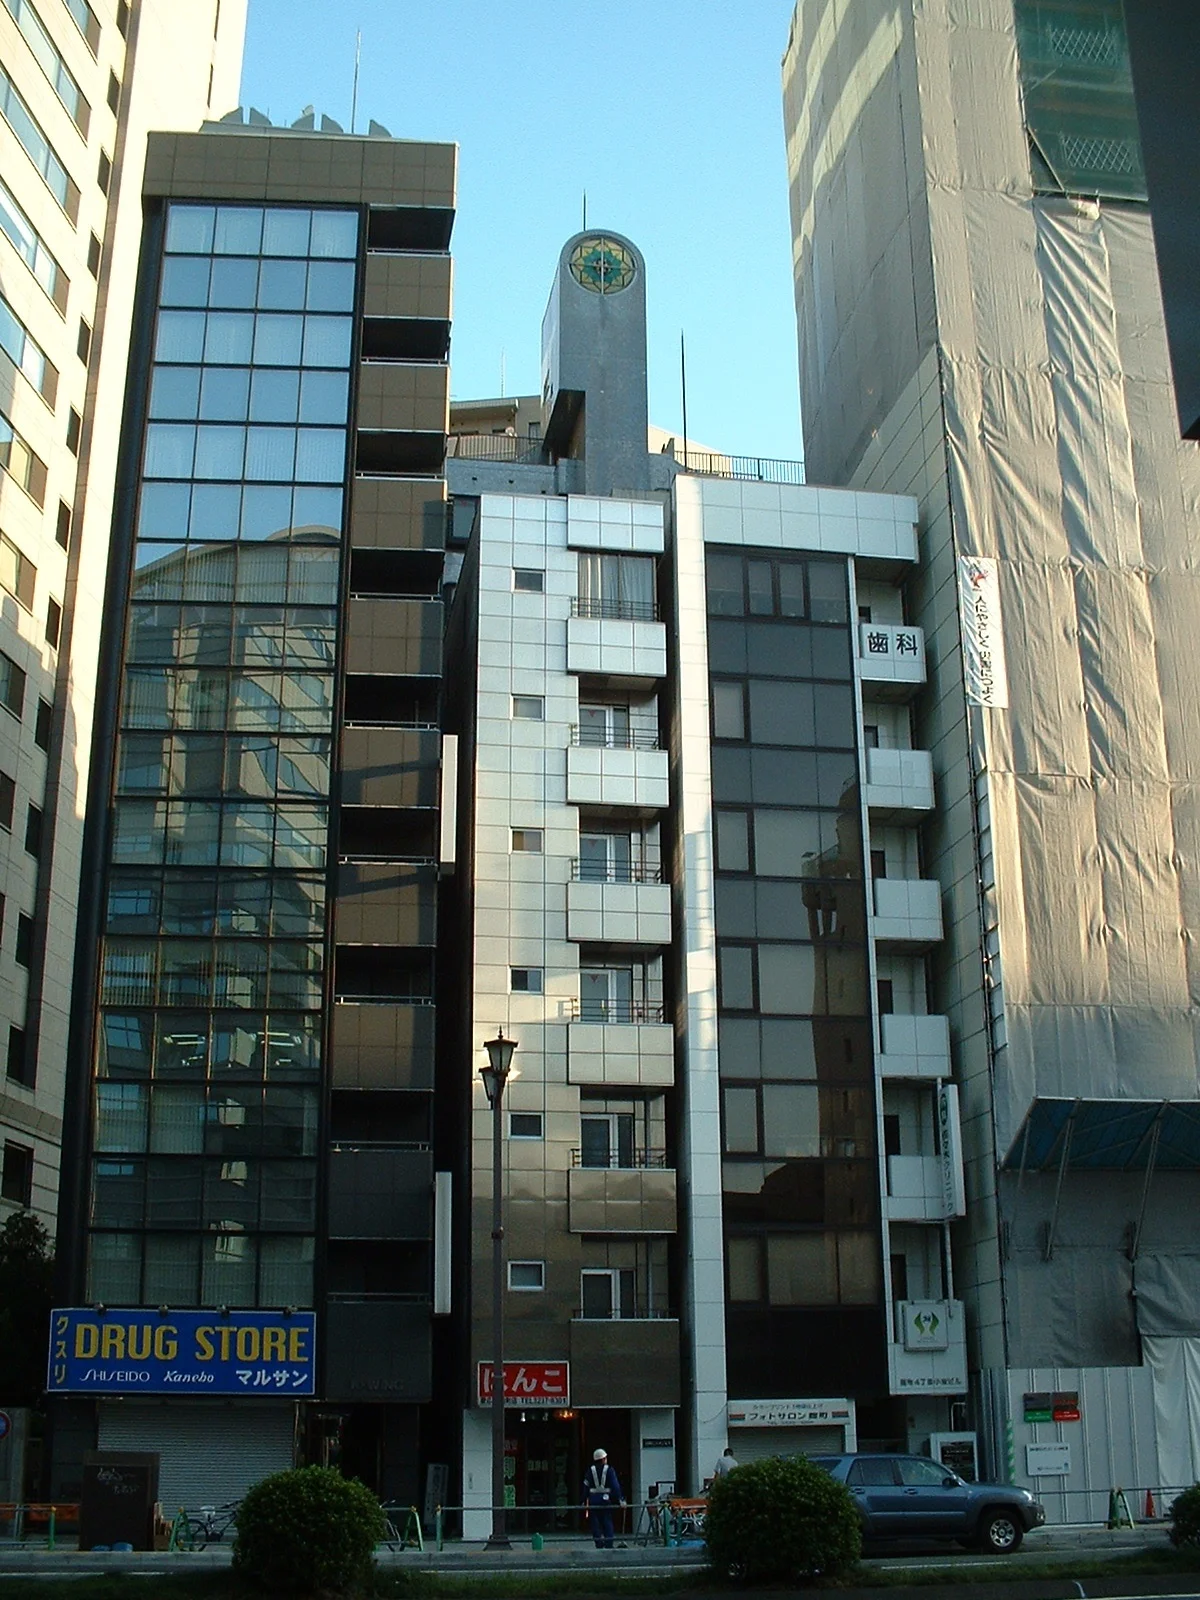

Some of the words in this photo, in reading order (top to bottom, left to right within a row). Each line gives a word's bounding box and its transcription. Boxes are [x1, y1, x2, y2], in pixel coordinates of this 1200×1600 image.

[868, 632, 917, 655] 歯科
[54, 1316, 69, 1383] クスリ
[75, 1323, 178, 1360] DRUG
[195, 1326, 309, 1362] STORE
[79, 1368, 151, 1383] SHISEIDO
[163, 1370, 215, 1384] Kanebo
[235, 1369, 309, 1388] マルサン
